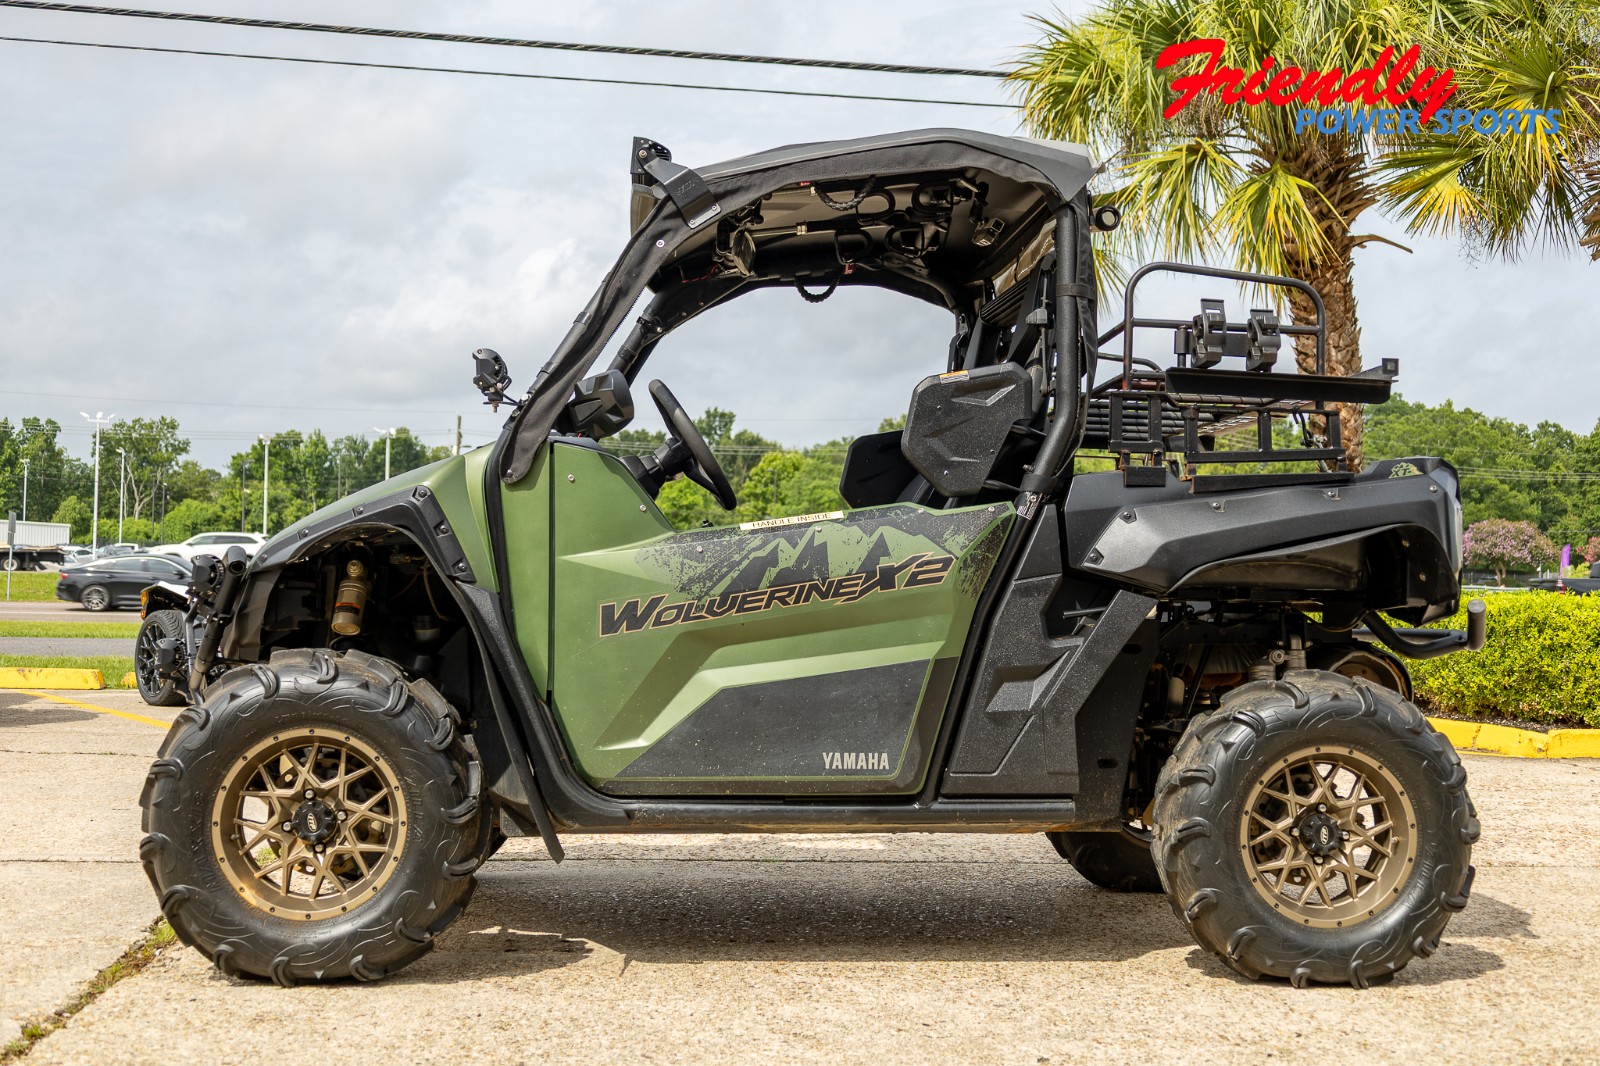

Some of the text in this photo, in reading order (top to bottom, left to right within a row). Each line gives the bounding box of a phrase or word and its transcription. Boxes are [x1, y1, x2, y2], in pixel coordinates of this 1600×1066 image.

[752, 513, 832, 528] HANDLE INSIDE
[822, 752, 890, 770] YAMAHA
